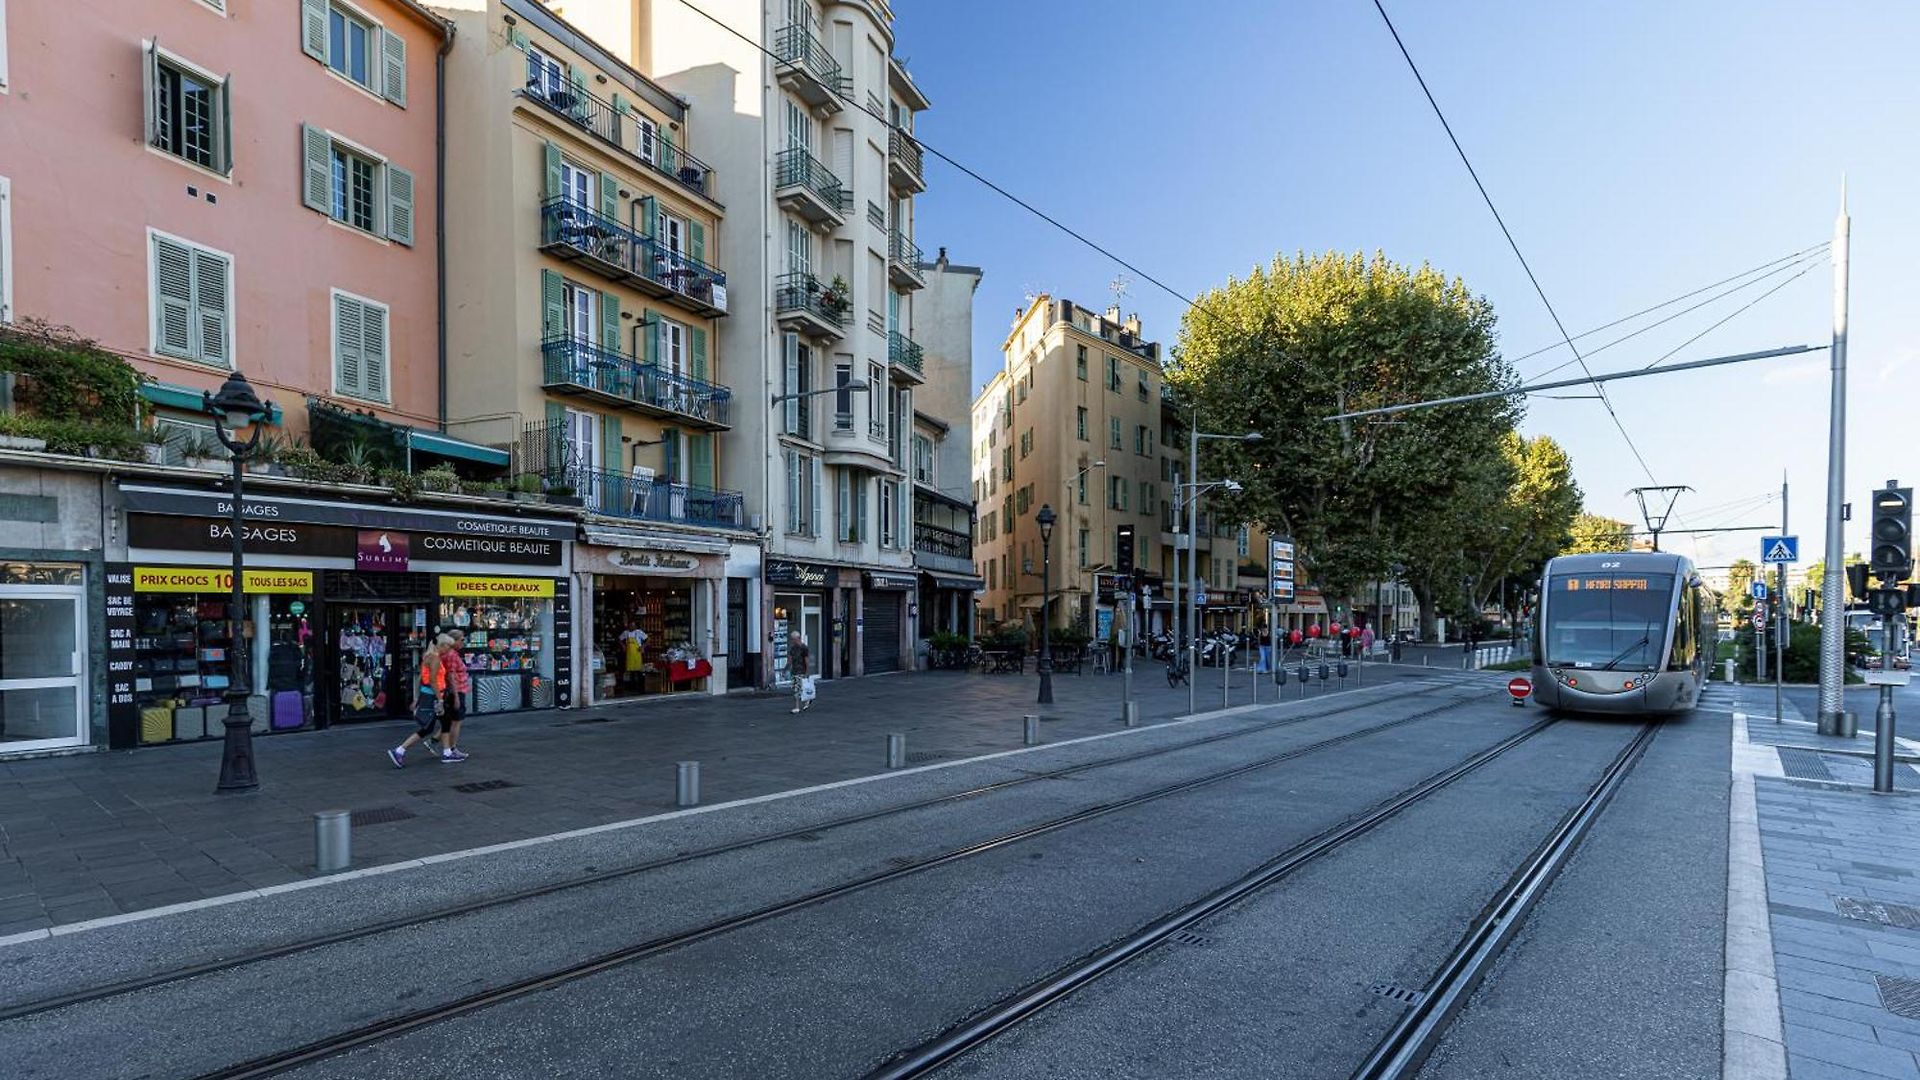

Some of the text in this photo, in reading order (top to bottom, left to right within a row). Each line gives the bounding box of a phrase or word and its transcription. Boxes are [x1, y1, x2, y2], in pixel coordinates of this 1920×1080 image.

[217, 502, 279, 517] BAAGES
[457, 520, 550, 536] COSMETIQUE BEAUTE
[423, 536, 551, 555] COSMETIQUE BEAUTE
[107, 574, 132, 585] VALISE
[140, 575, 167, 585] PRIX
[170, 575, 209, 586] CHOCS
[250, 577, 308, 588] TOUS LES SACS
[456, 581, 540, 592] IDEES CADEAUX
[107, 606, 133, 617] VOYAGE
